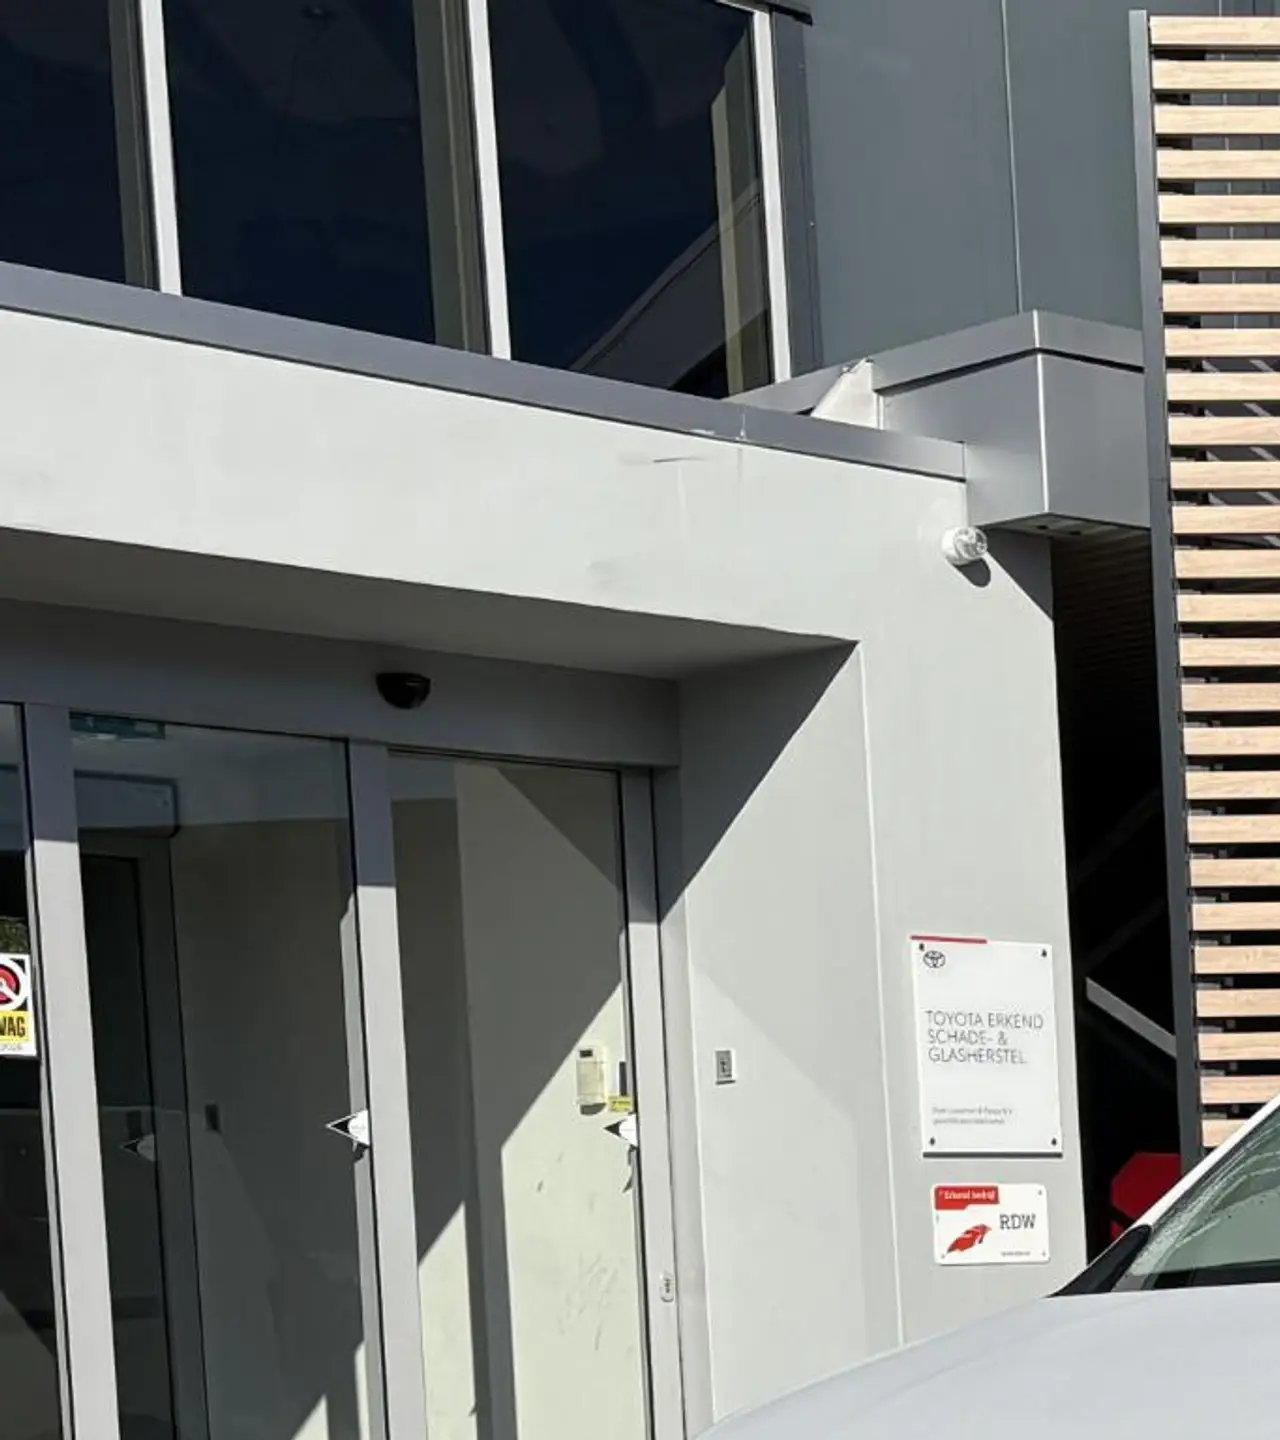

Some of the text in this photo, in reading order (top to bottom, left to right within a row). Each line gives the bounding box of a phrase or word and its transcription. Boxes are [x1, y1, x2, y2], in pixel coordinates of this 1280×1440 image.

[925, 1010, 1044, 1029] TOYOTA ERKEND
[928, 1029, 1008, 1046] SCHADE- &
[928, 1046, 1028, 1064] GLASHERSTEL
[999, 1213, 1037, 1230] RDW
